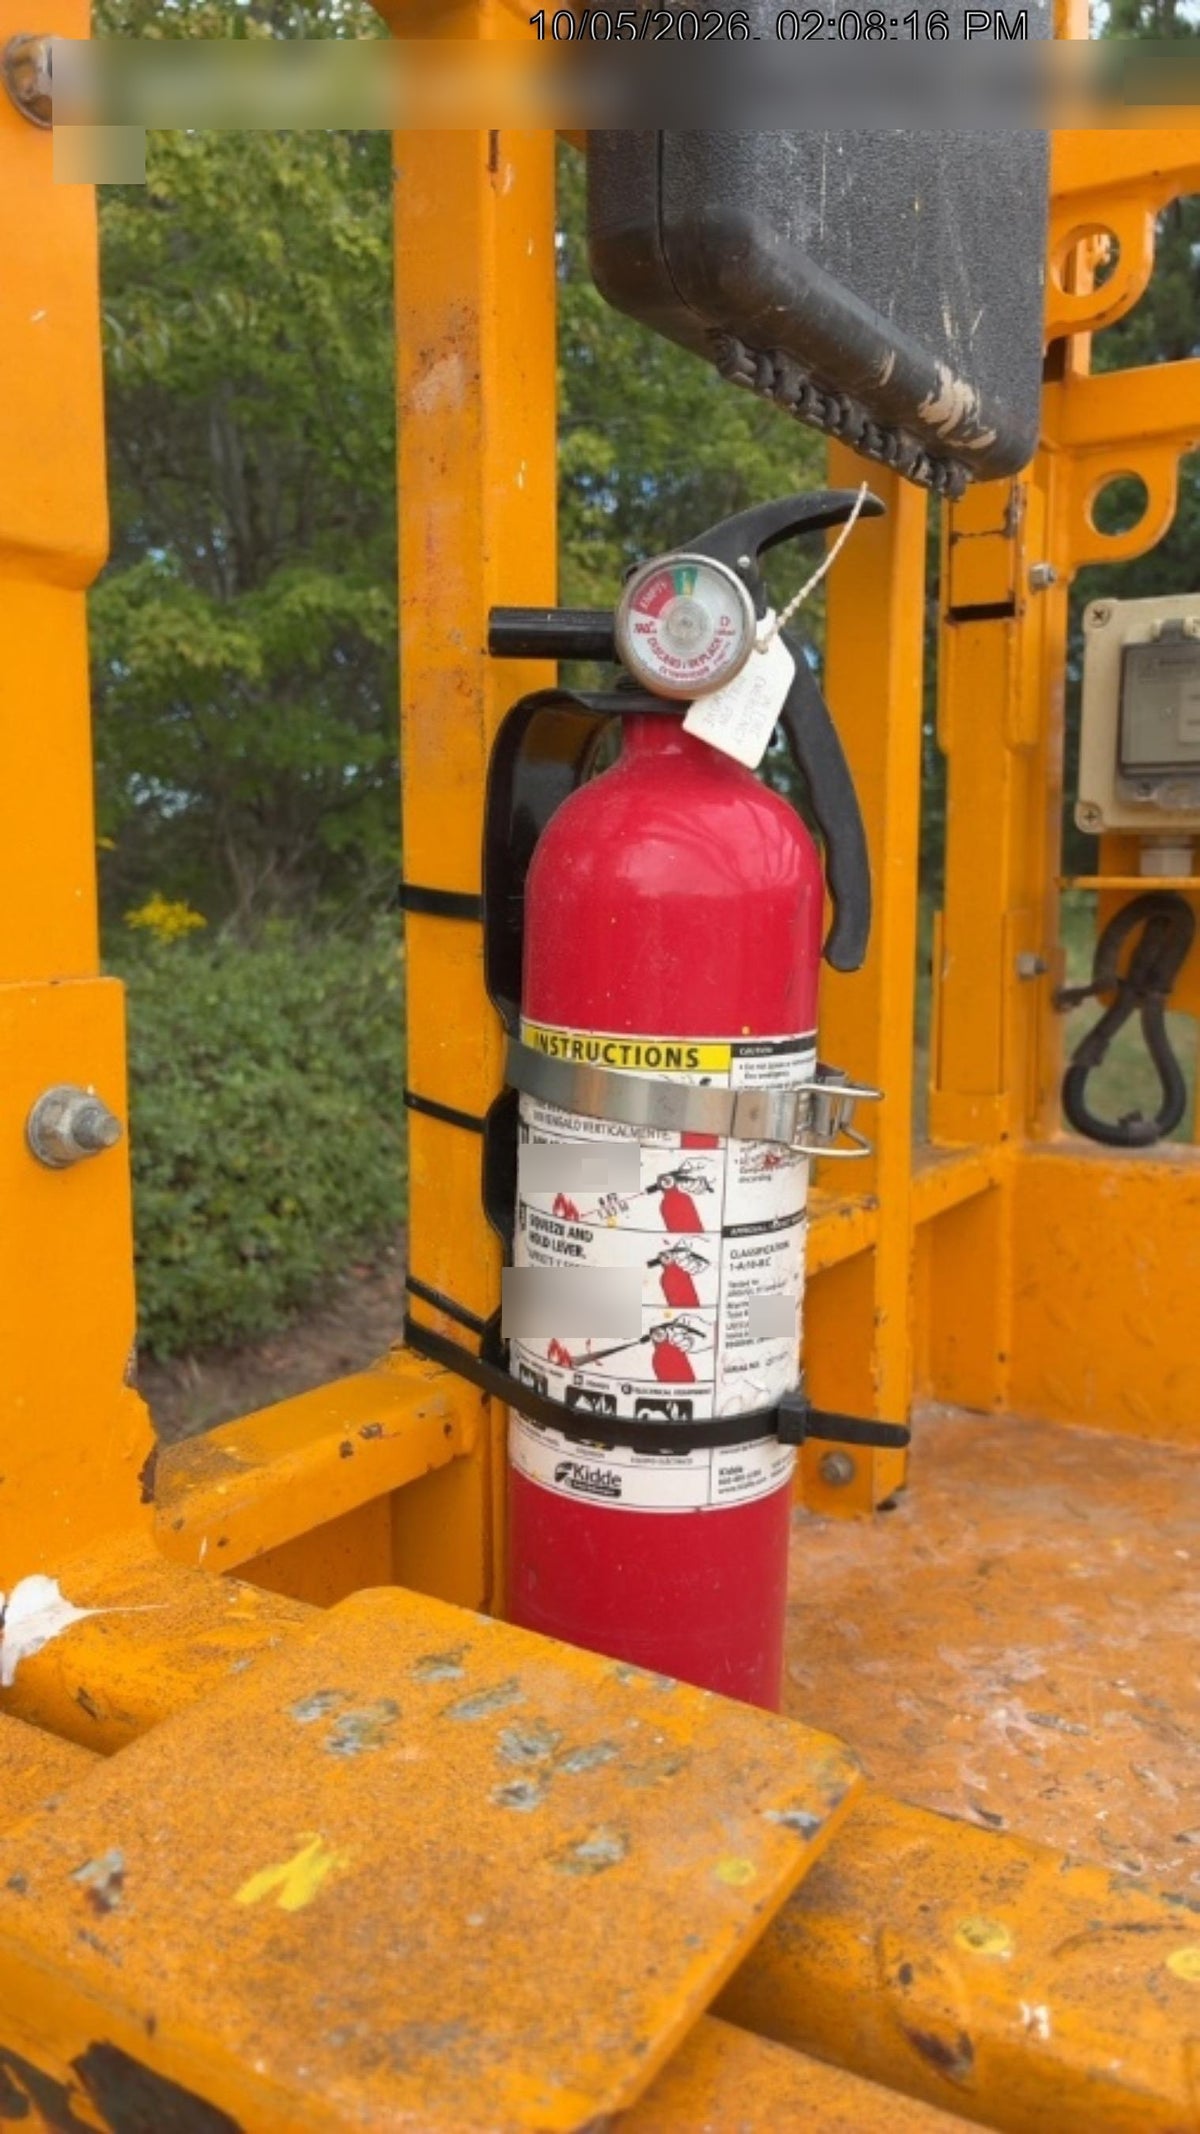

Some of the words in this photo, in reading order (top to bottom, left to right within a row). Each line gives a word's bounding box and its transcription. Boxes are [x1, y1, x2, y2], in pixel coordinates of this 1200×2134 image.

[532, 1031, 700, 1069] INSTRUCTIONS
[567, 1227, 594, 1244] AND
[572, 1463, 622, 1488] Kidde
